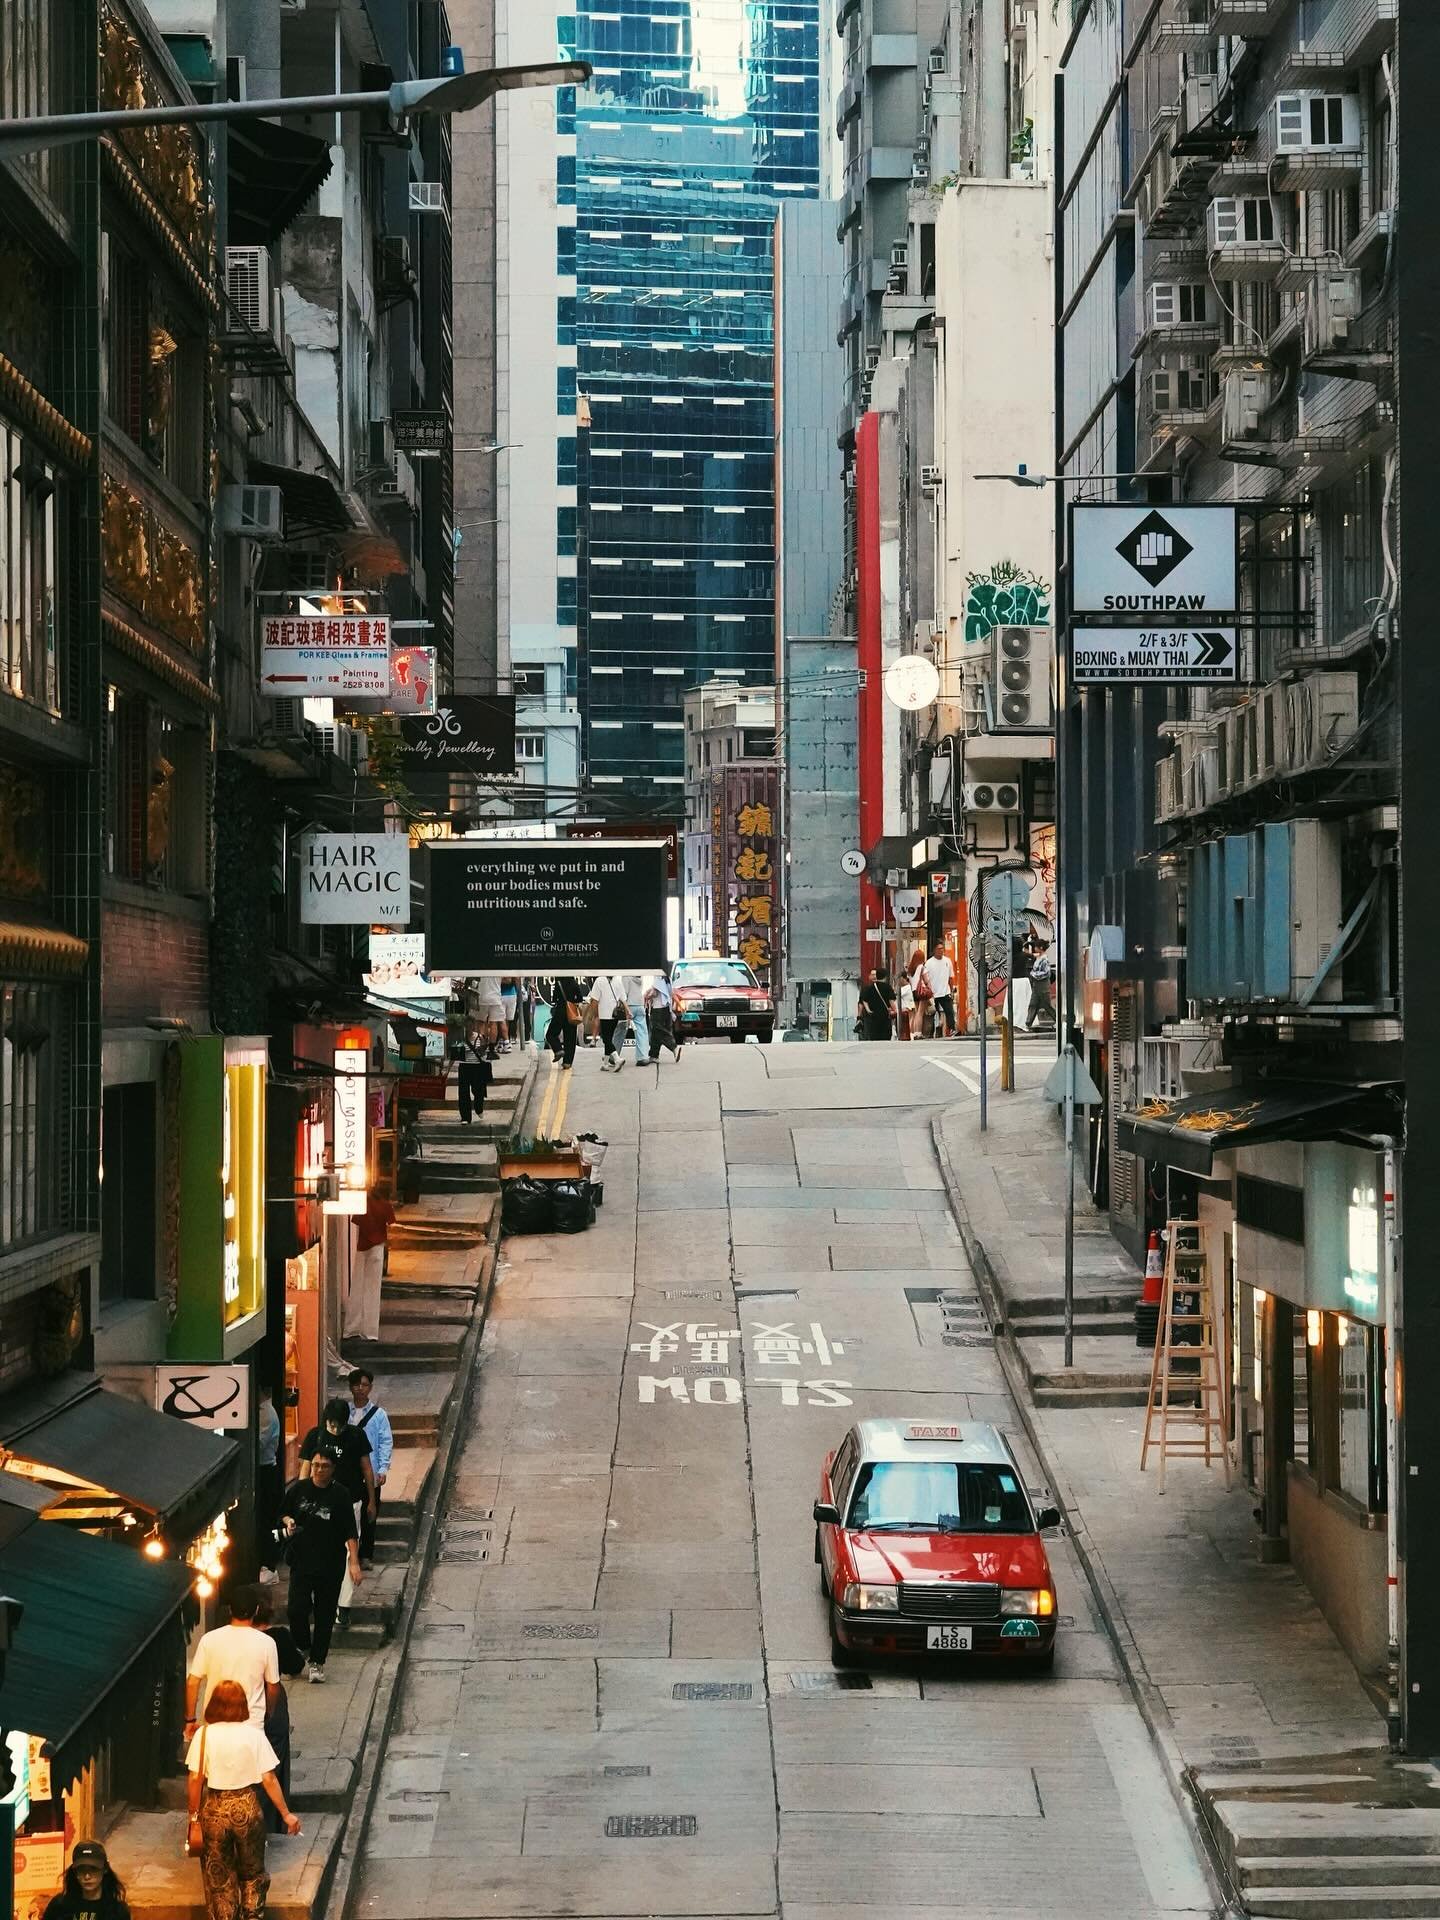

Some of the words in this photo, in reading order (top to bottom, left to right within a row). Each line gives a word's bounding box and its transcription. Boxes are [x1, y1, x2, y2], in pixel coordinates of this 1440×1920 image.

[1103, 595, 1206, 610] SOUTHPAW
[266, 620, 386, 646] 波記玻璃相架畫架
[1139, 633, 1159, 648] 2/F
[1160, 637, 1168, 647] &
[1169, 633, 1188, 648] 3/F
[298, 651, 314, 659] POR
[315, 651, 330, 659] KEE
[331, 651, 352, 659] Glass
[353, 651, 359, 659] &
[360, 651, 387, 659] Frames
[1075, 651, 1117, 666] BOXING
[1119, 656, 1126, 666] &
[1128, 651, 1160, 666] MUAY
[1164, 651, 1189, 666] THAI
[343, 670, 379, 678] Painting
[391, 690, 411, 698] CARE
[437, 740, 497, 760] Jewellery
[309, 846, 377, 866] HAIR
[467, 861, 535, 876] everything
[539, 864, 557, 873] we
[560, 863, 581, 876] put
[585, 861, 598, 872] in
[601, 861, 625, 872] and
[309, 871, 401, 892] MAGIC
[467, 882, 482, 891] on
[485, 881, 507, 891] our
[510, 879, 550, 891] bodies
[553, 880, 583, 891] must
[586, 879, 601, 891] be
[467, 898, 530, 909] nutritious
[532, 898, 556, 908] and
[558, 897, 587, 908] safe.
[379, 906, 401, 916] M/F
[494, 944, 548, 952] INTELLIGENT
[551, 944, 600, 952] NUTRIENTS
[344, 1057, 356, 1097] FOOT
[638, 1375, 854, 1407] SLOW
[911, 1426, 957, 1437] TAXI
[940, 1627, 959, 1638] LS
[1016, 1623, 1025, 1631] 4
[931, 1638, 968, 1649] 4888
